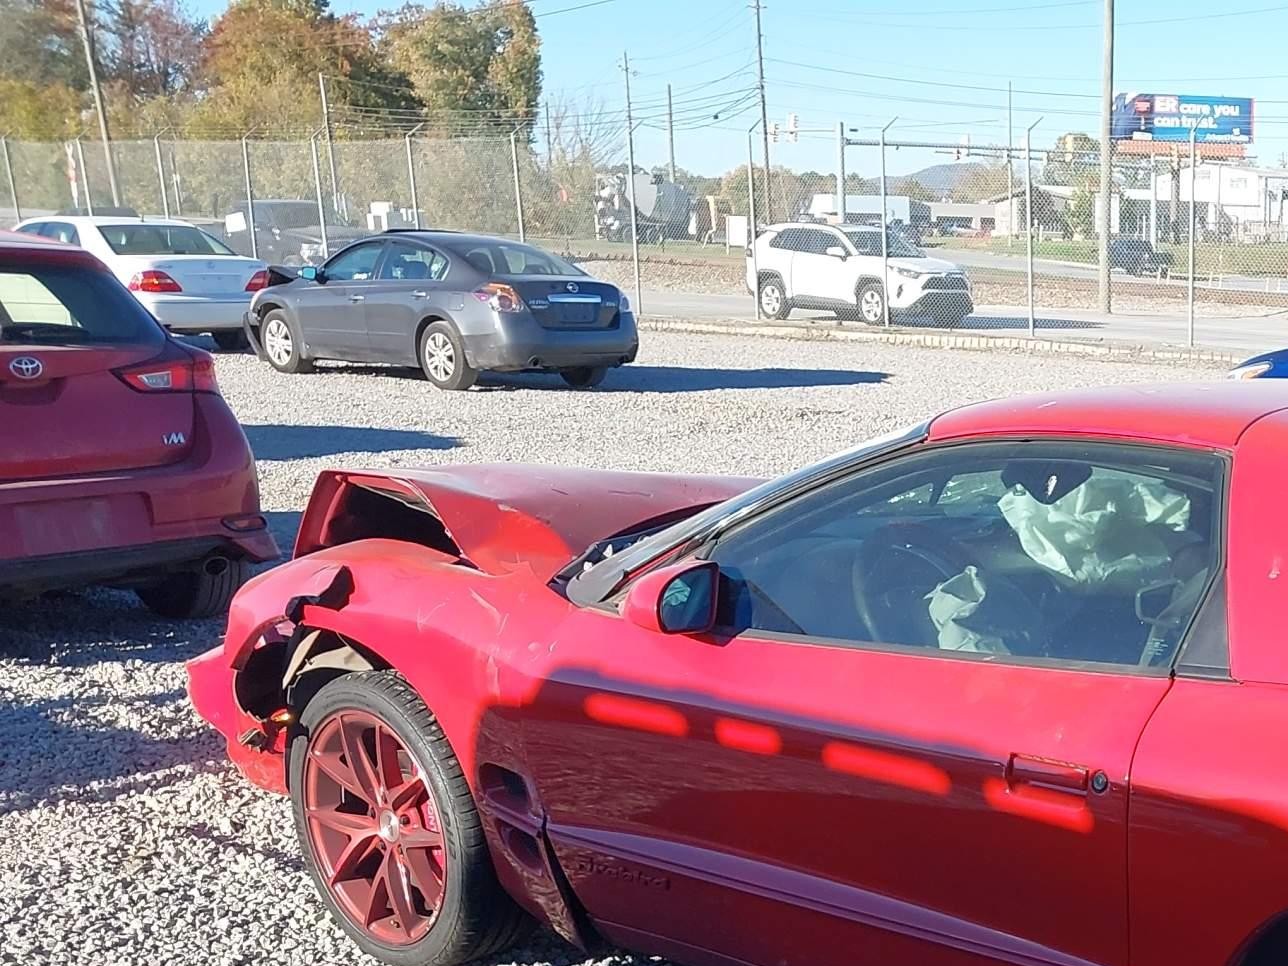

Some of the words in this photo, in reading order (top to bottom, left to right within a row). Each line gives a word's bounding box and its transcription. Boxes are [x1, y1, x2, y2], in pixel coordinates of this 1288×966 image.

[1155, 97, 1178, 113] ER
[1179, 103, 1211, 115] care
[1213, 105, 1240, 119] you
[1153, 116, 1180, 128] can
[1181, 115, 1218, 129] trust.
